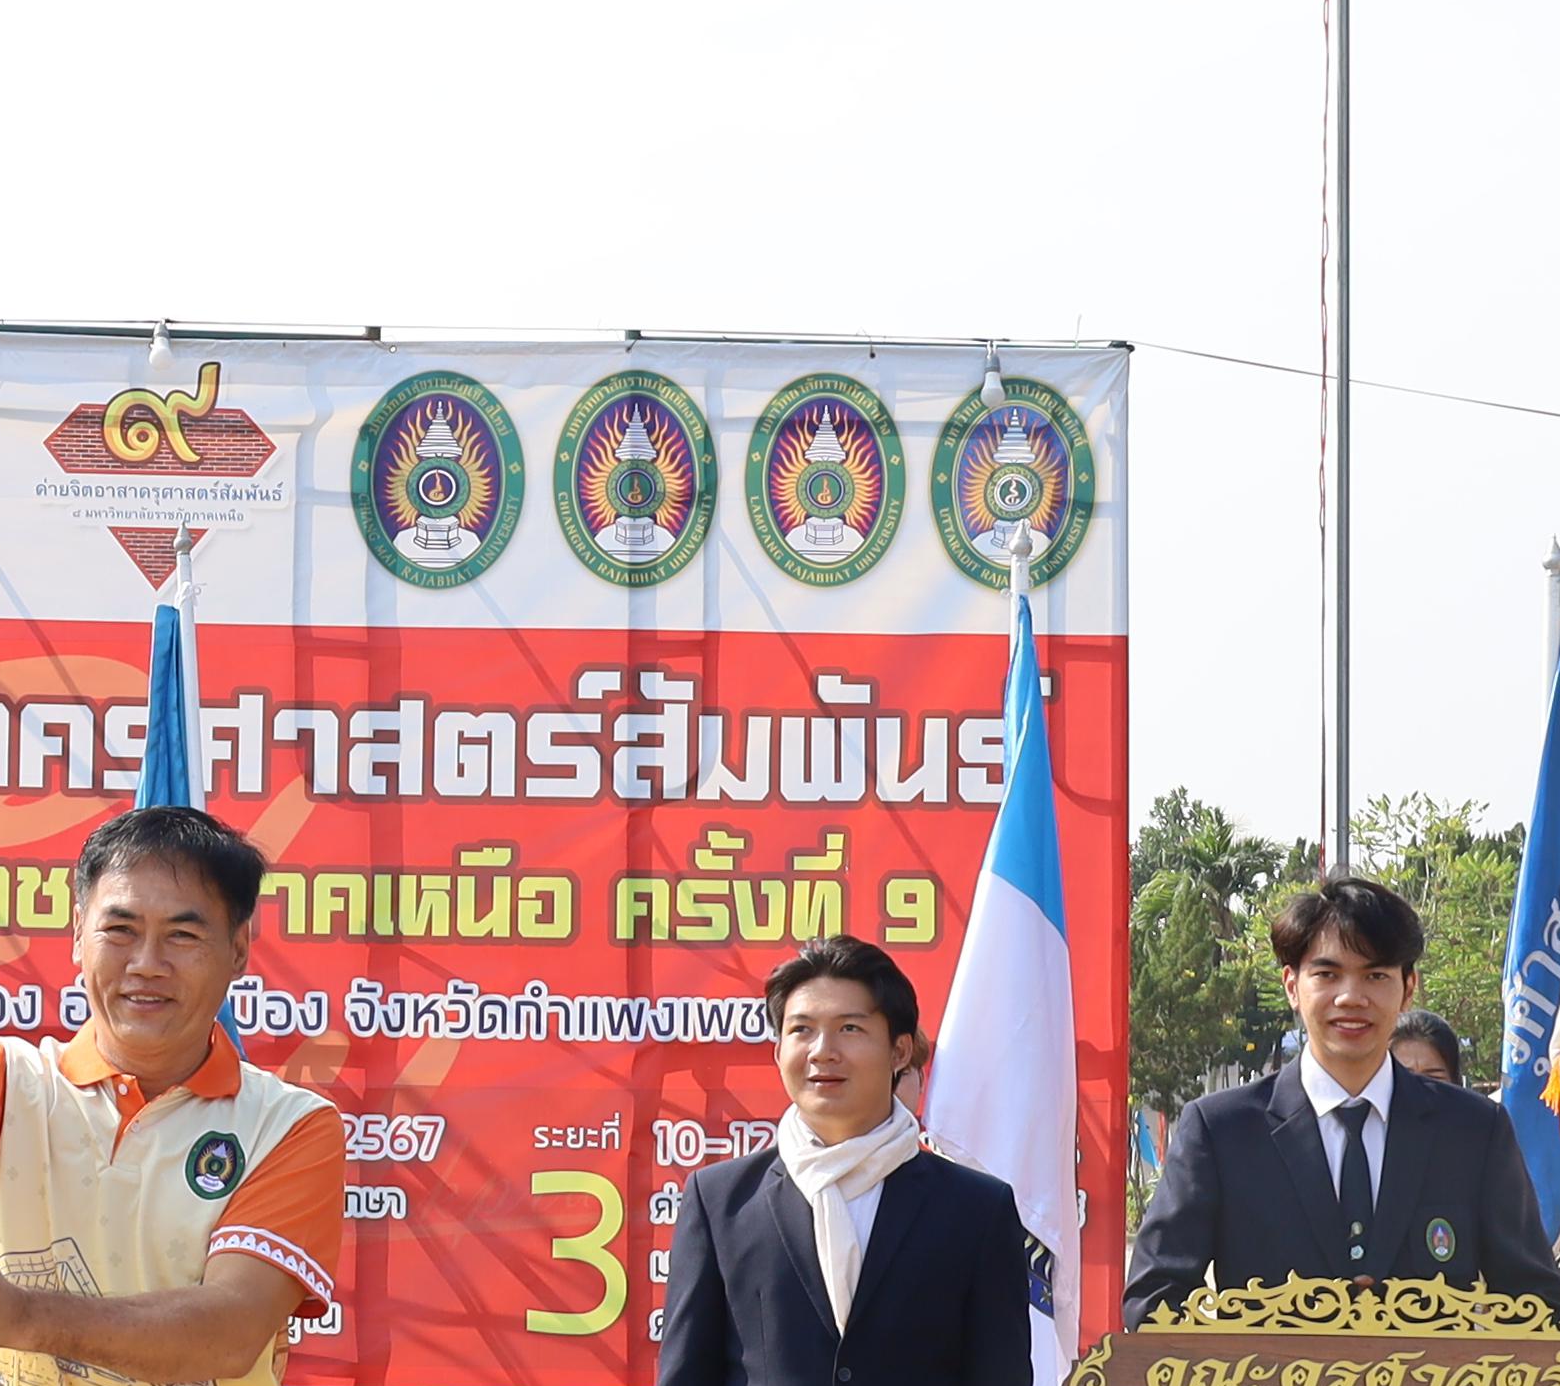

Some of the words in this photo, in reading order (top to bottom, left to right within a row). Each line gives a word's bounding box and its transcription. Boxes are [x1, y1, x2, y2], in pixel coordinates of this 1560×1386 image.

[357, 491, 379, 546] CHIANG
[374, 540, 398, 568] MAI
[401, 566, 474, 589] RAJABHAT
[480, 494, 520, 572] UNIVERSITY
[558, 491, 596, 566] CHIANGRAI
[596, 562, 667, 585] RAJABHAT
[669, 491, 713, 570] UNIVERSITY
[749, 494, 785, 564] LAMPANG
[784, 559, 852, 584] RAJABHAT
[855, 497, 901, 572] UNIVERSITY
[938, 507, 979, 575] UTTARADIT
[1042, 507, 1087, 575] UNIVERSITY
[616, 830, 844, 941] ครั้งที่
[349, 982, 778, 1039] จังหวัดกำแพงเพช
[534, 1112, 620, 1150] ระยะที่
[526, 1170, 628, 1336] 3
